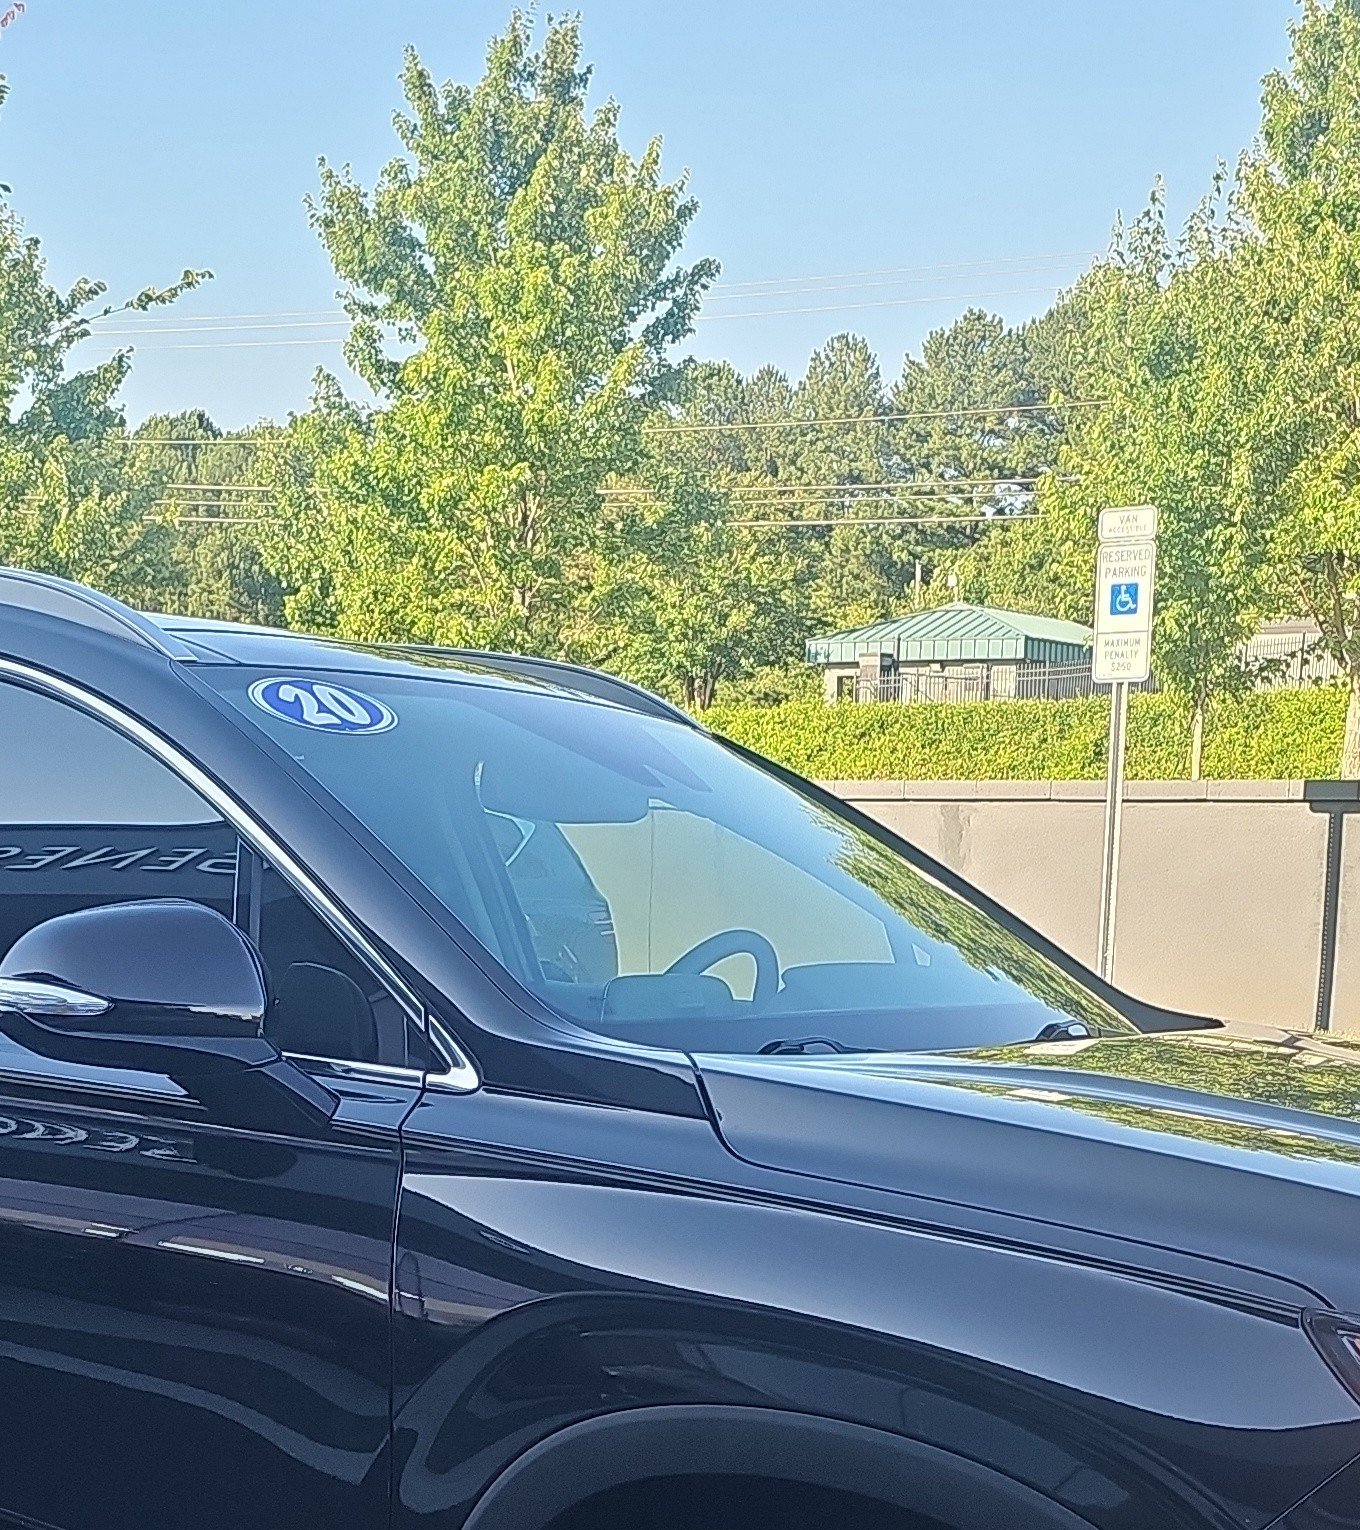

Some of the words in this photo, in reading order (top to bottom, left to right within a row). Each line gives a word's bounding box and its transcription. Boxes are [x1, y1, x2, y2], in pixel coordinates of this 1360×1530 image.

[1119, 514, 1139, 525] VAN
[1102, 548, 1151, 563] RESERVED
[1104, 565, 1147, 579] PARKING
[1103, 637, 1142, 648] MAXIMUM
[1104, 649, 1139, 660] PENALTY
[1111, 661, 1132, 672] $250
[277, 683, 373, 726] 20
